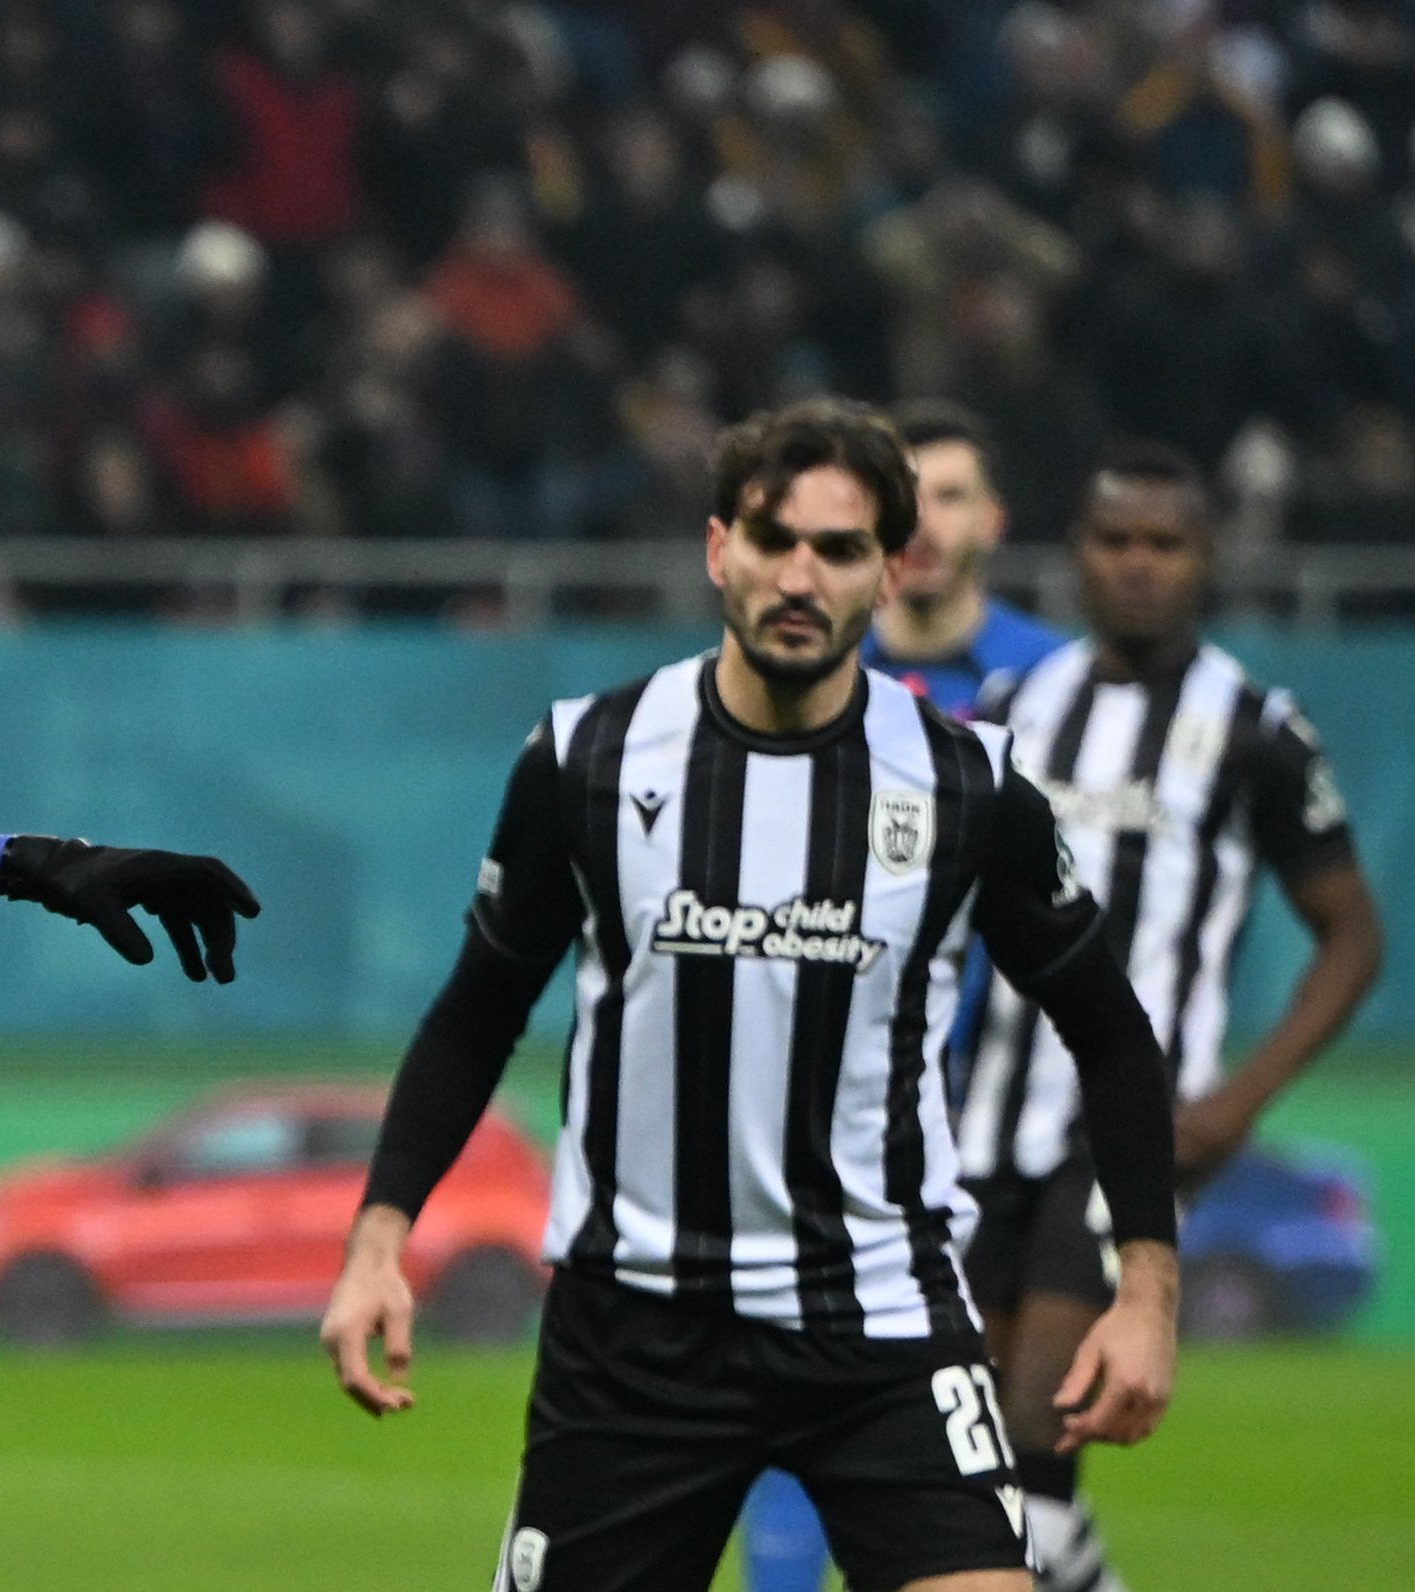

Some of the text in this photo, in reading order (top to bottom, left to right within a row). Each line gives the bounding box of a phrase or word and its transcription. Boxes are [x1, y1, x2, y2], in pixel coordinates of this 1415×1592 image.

[657, 890, 769, 955] Stop
[773, 898, 857, 934] child
[762, 930, 885, 973] obesity
